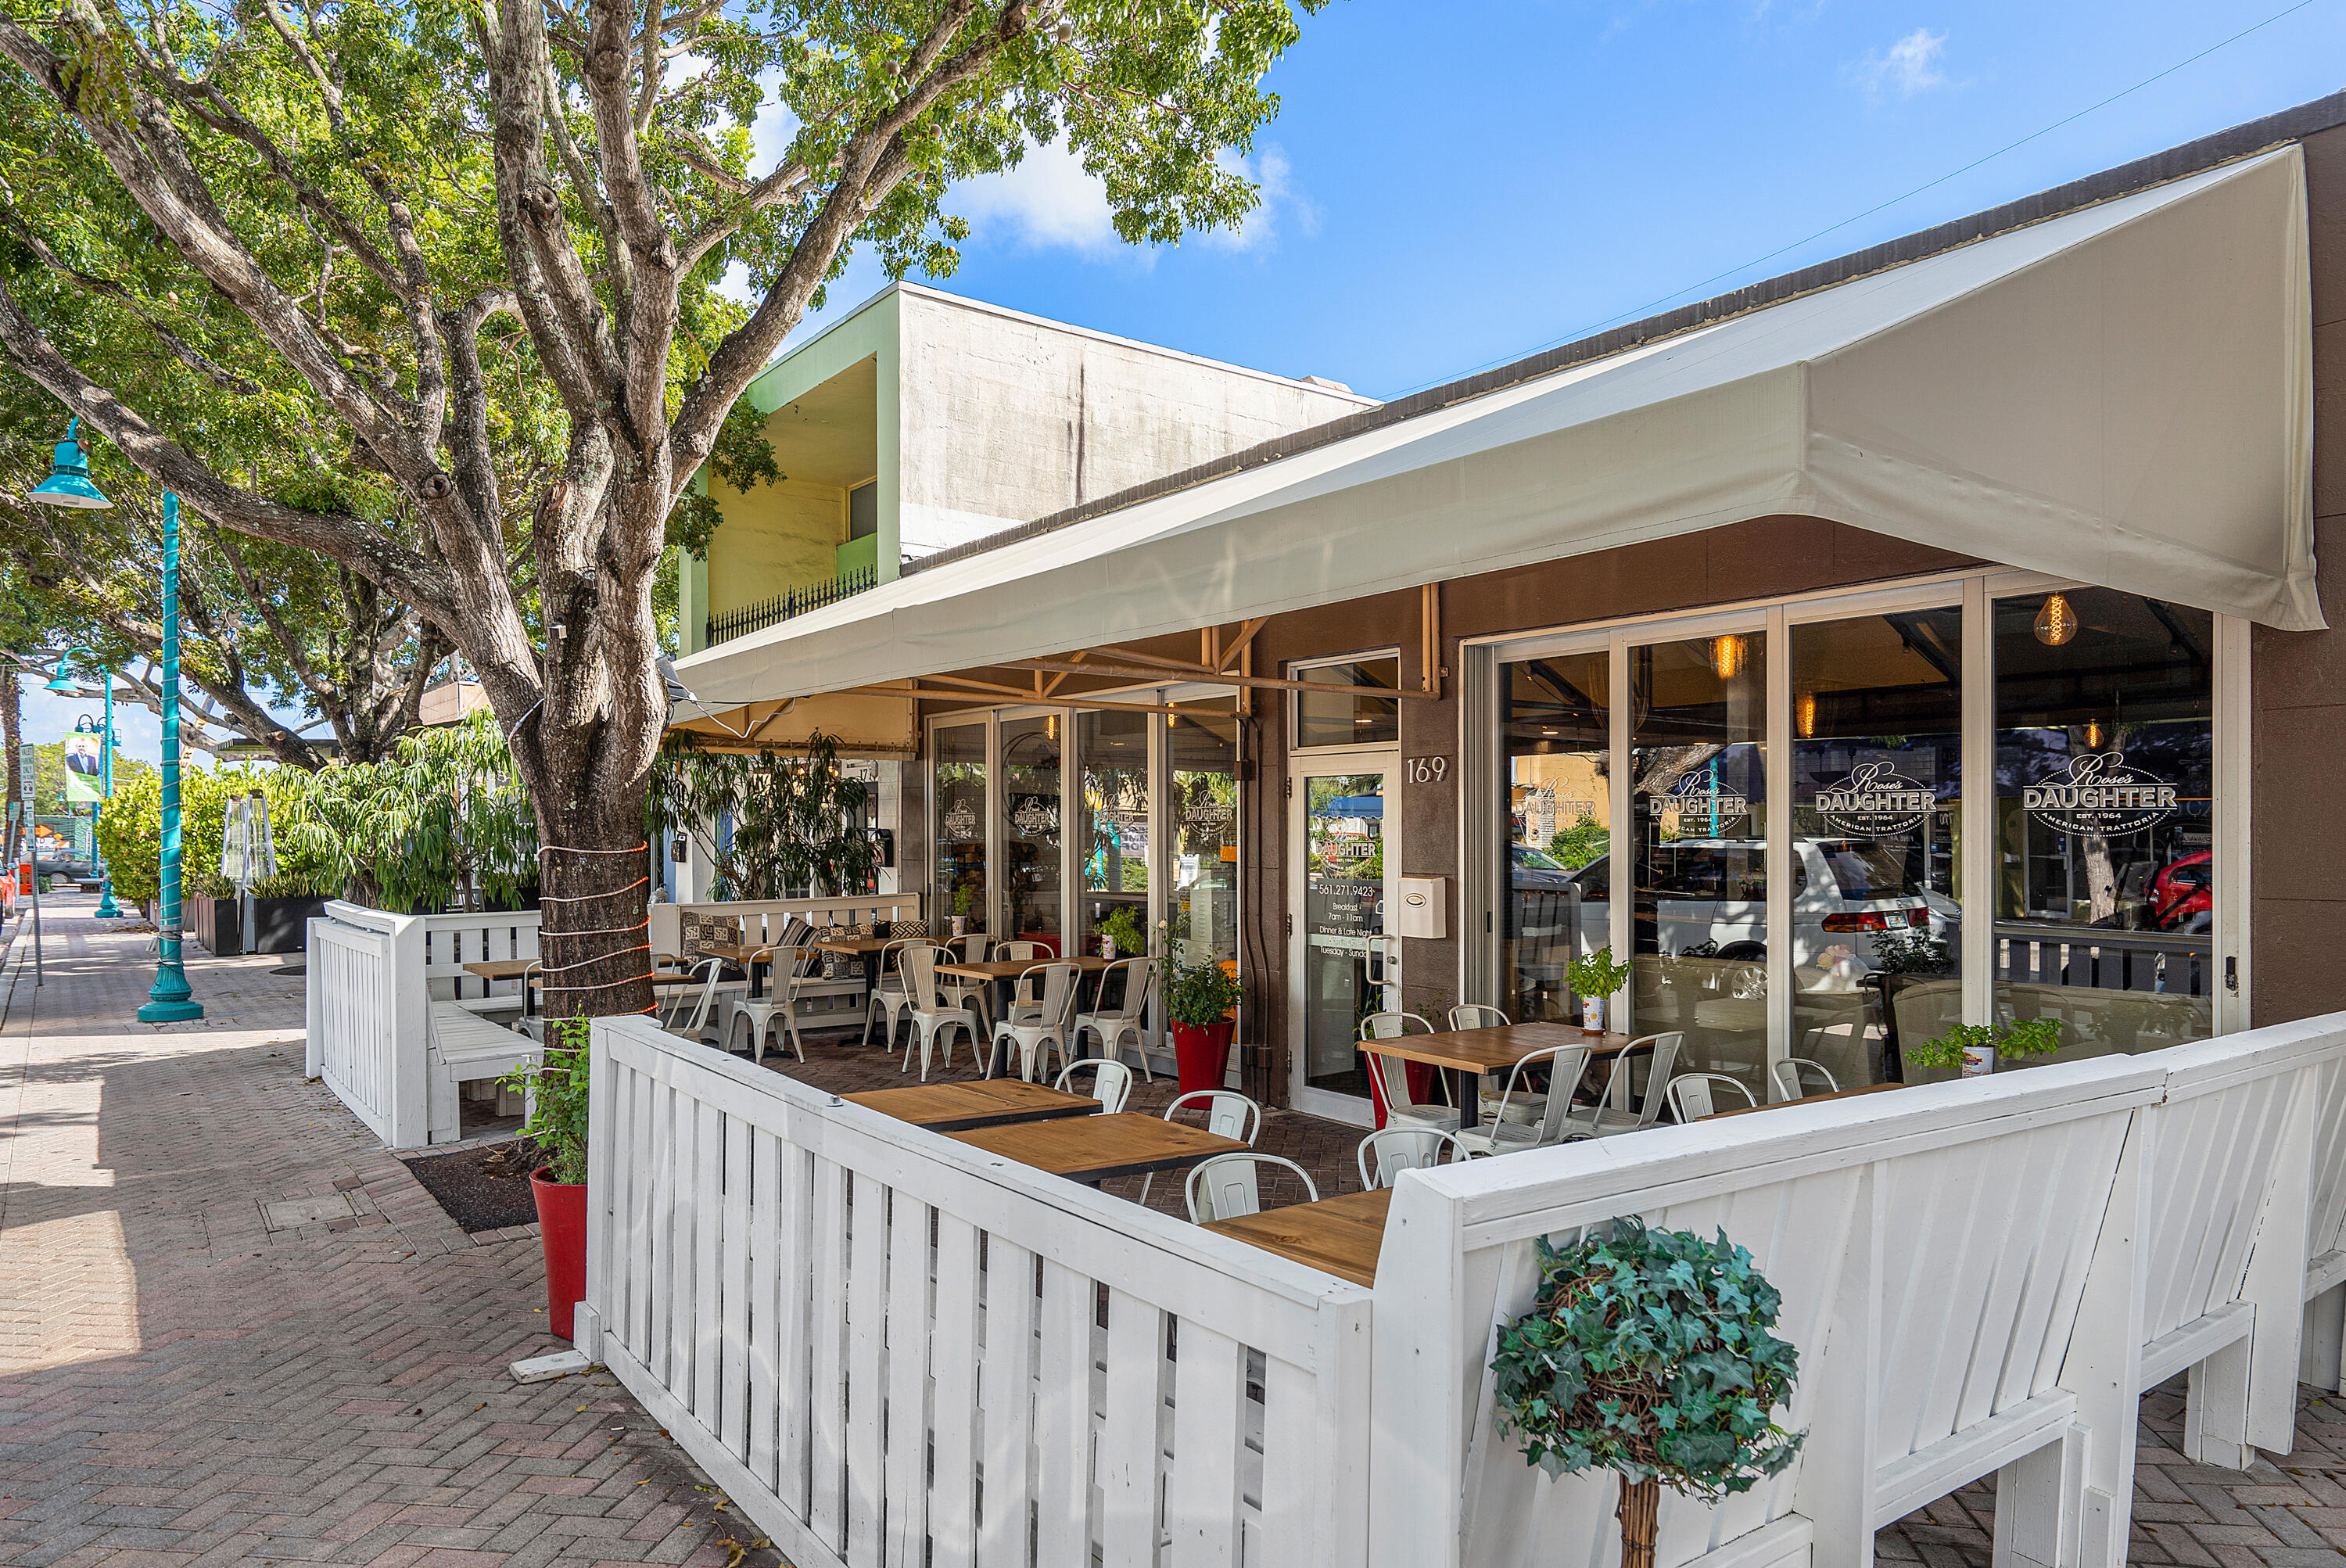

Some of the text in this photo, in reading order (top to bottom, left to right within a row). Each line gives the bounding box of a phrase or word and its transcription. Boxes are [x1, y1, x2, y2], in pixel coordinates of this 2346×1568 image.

[1408, 756, 1446, 783] 169
[2042, 752, 2135, 789] Rose's
[1830, 761, 1903, 795] Rose's
[1815, 791, 1937, 811] DAUGHTER
[2023, 787, 2177, 808] DAUGHTER
[1515, 799, 1596, 816] DAUGHTER
[1649, 797, 1748, 814] DAUGHTER
[945, 814, 976, 823] DAUGHTER
[1014, 813, 1049, 823] DAUGHTER
[1186, 808, 1232, 820] DAUGHTER
[1830, 814, 1923, 832] AMERICAN TRATTORIA
[2041, 812, 2160, 832] AMERICAN TRATTORIA
[1315, 842, 1376, 856] DAUGHTER
[1318, 884, 1373, 897] 561.271.9423
[1333, 902, 1358, 911] Breakfast
[1328, 912, 1341, 920] 7am
[1347, 913, 1363, 922] 11am
[1343, 928, 1356, 936] Late
[1357, 928, 1372, 938] Night
[1320, 945, 1344, 956] Tuesday
[1348, 949, 1367, 958] Sunda
